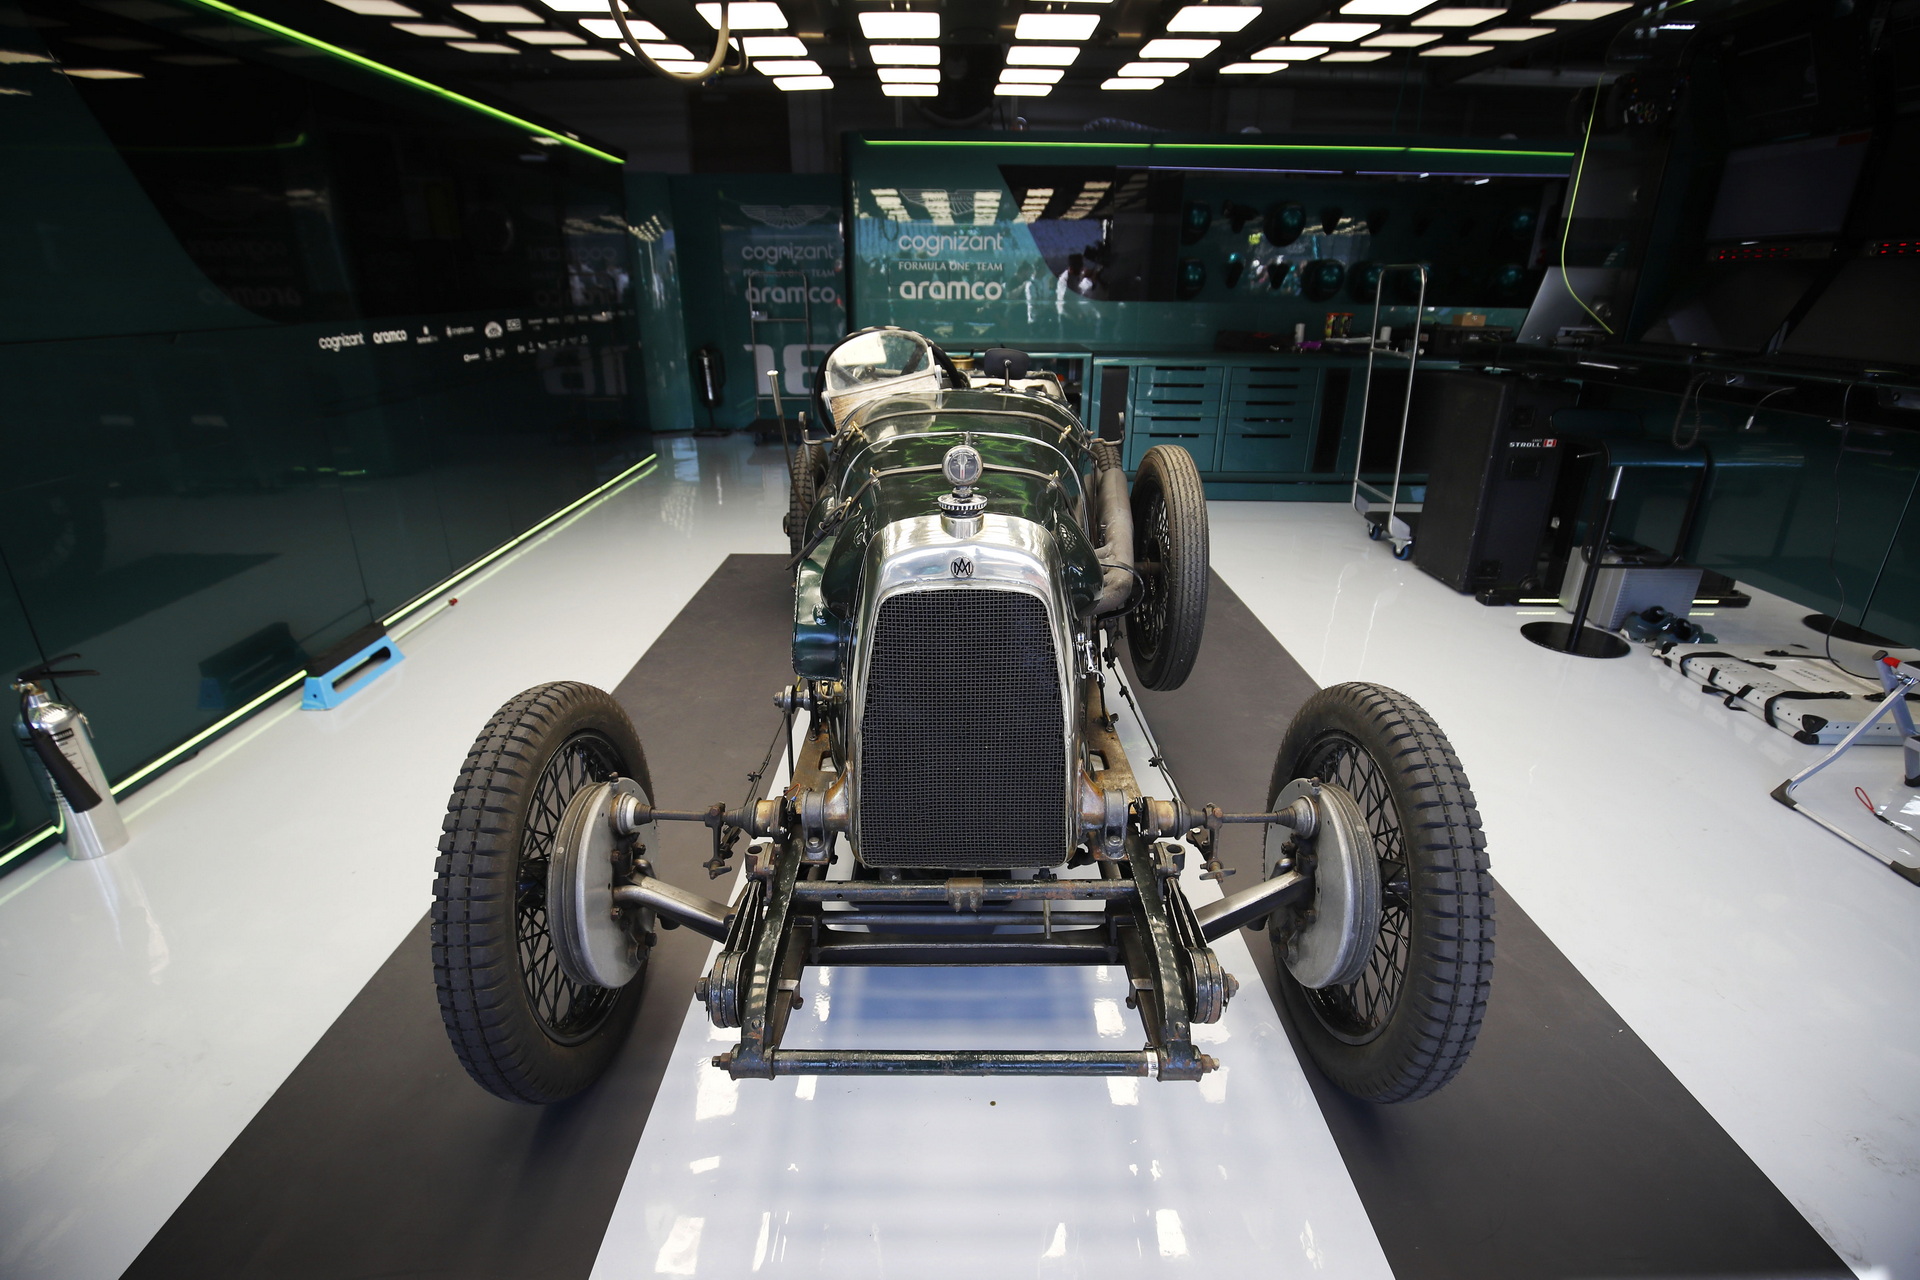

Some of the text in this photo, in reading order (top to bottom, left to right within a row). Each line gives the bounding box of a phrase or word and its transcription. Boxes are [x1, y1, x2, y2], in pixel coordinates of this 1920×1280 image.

[741, 243, 834, 265] cognizant
[898, 231, 1003, 256] cognizant
[898, 261, 1003, 271] FORMULA ONE TEAM
[744, 286, 836, 304] aramco
[899, 280, 1003, 300] aramco
[318, 331, 366, 353] cognizant
[372, 329, 408, 345] aramco
